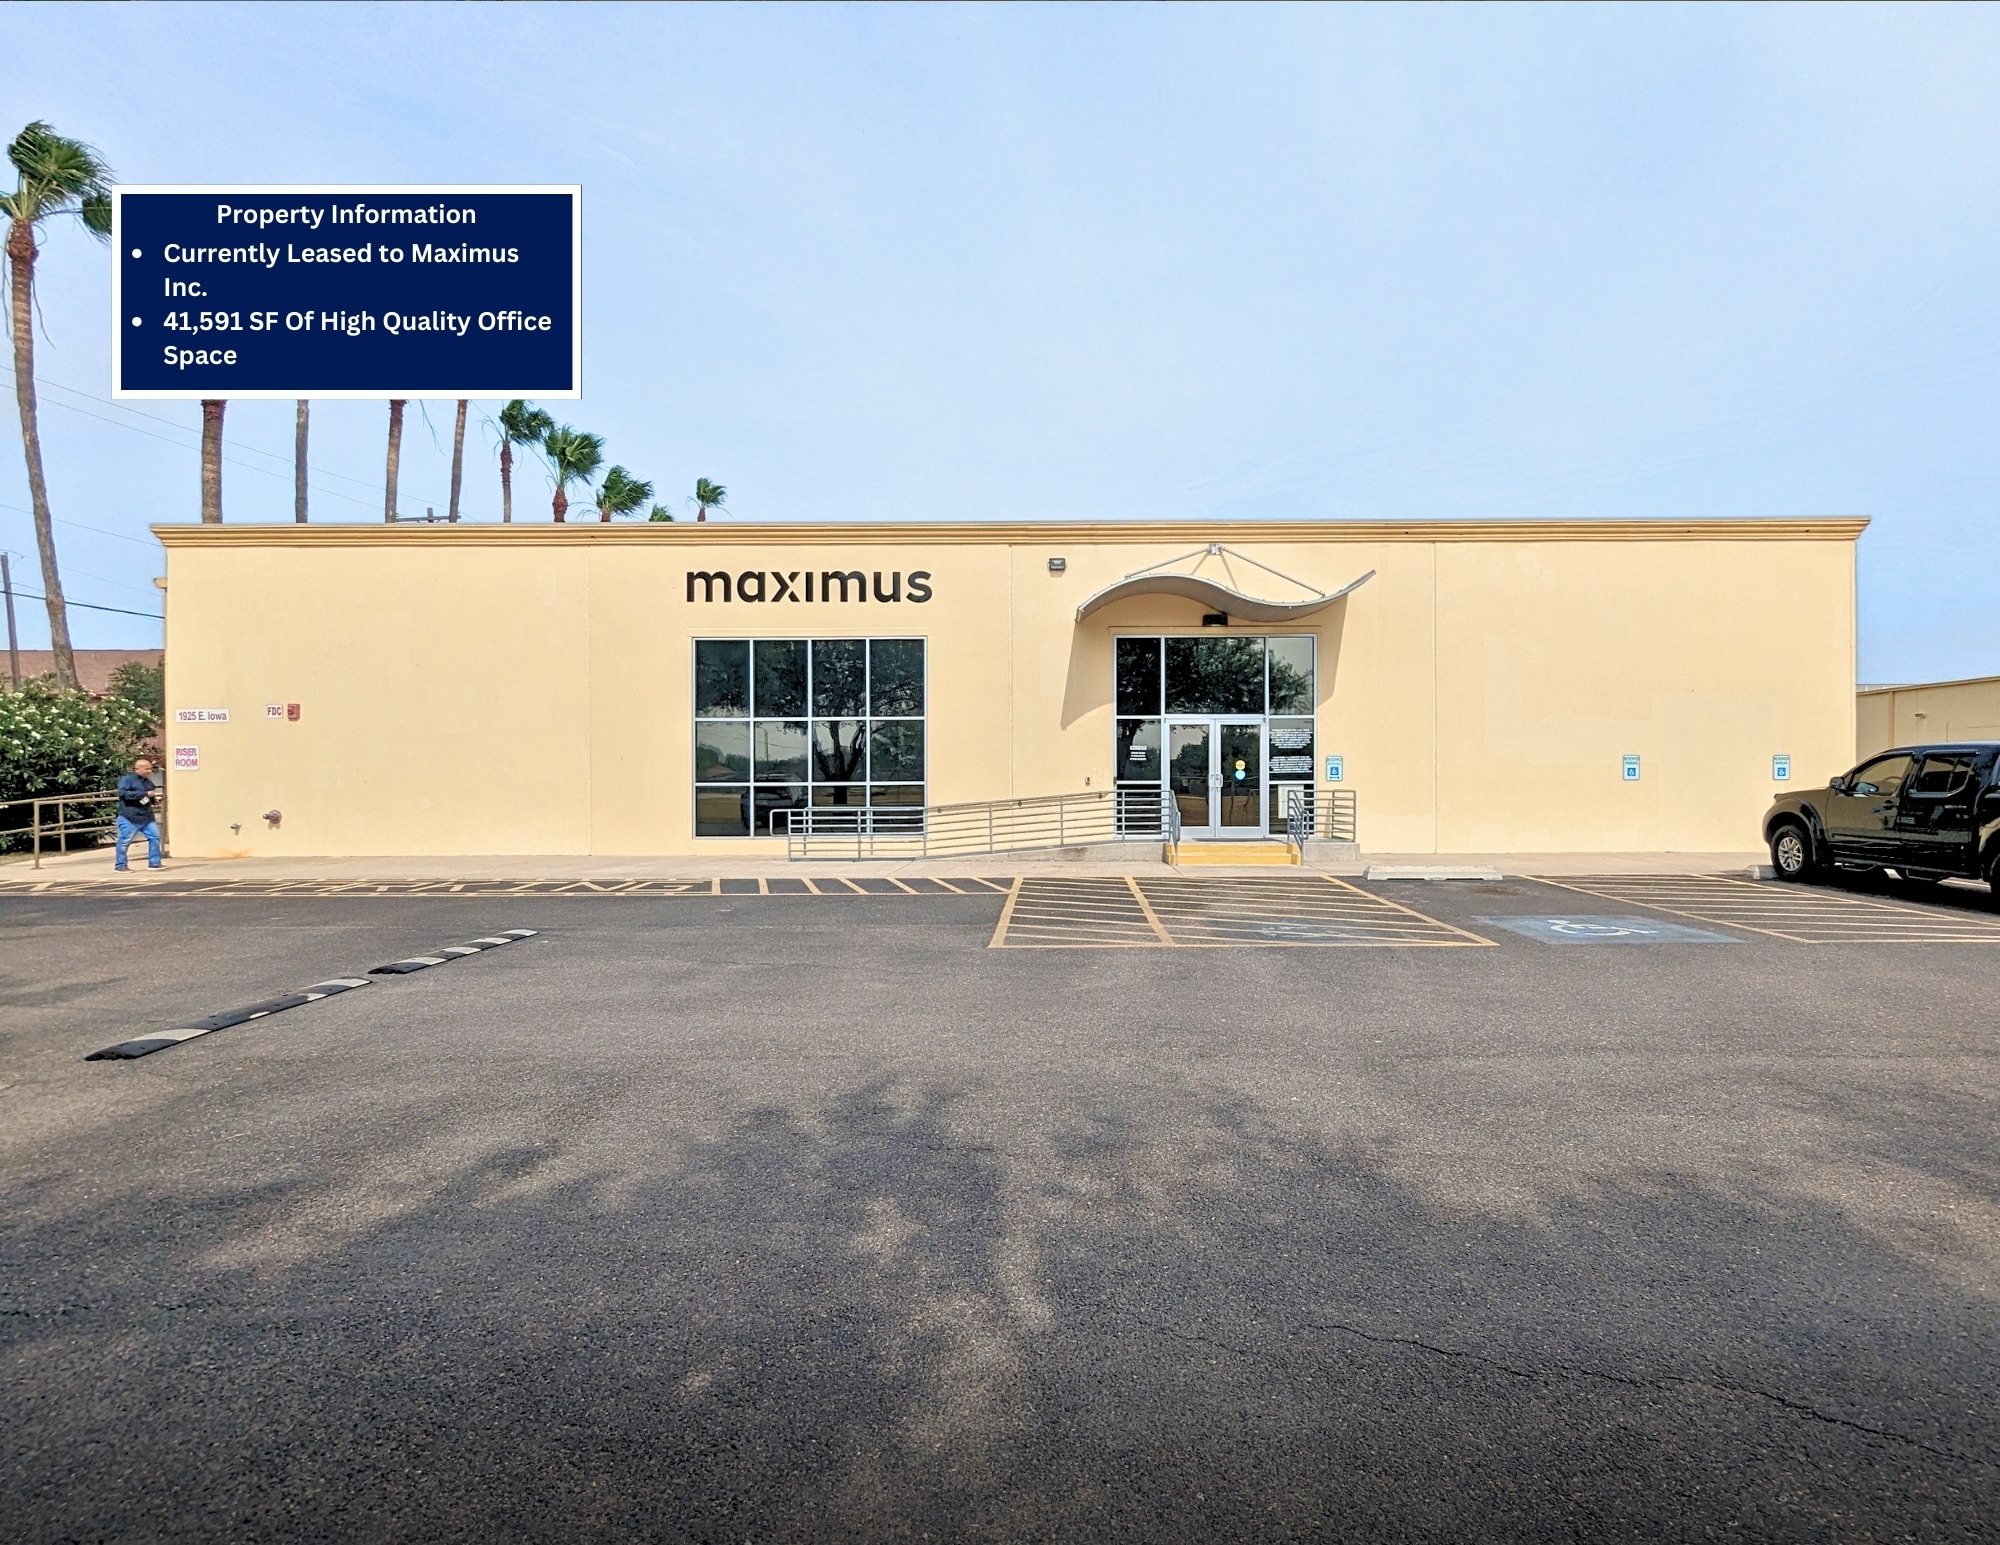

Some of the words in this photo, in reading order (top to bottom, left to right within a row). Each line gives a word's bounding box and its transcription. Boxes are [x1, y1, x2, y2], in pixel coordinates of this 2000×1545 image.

[686, 570, 933, 603] maximus
[179, 711, 197, 721] 1925
[207, 711, 227, 721] Iowa
[267, 706, 282, 716] FDC
[175, 748, 197, 757] RISER
[175, 758, 198, 767] ROOM
